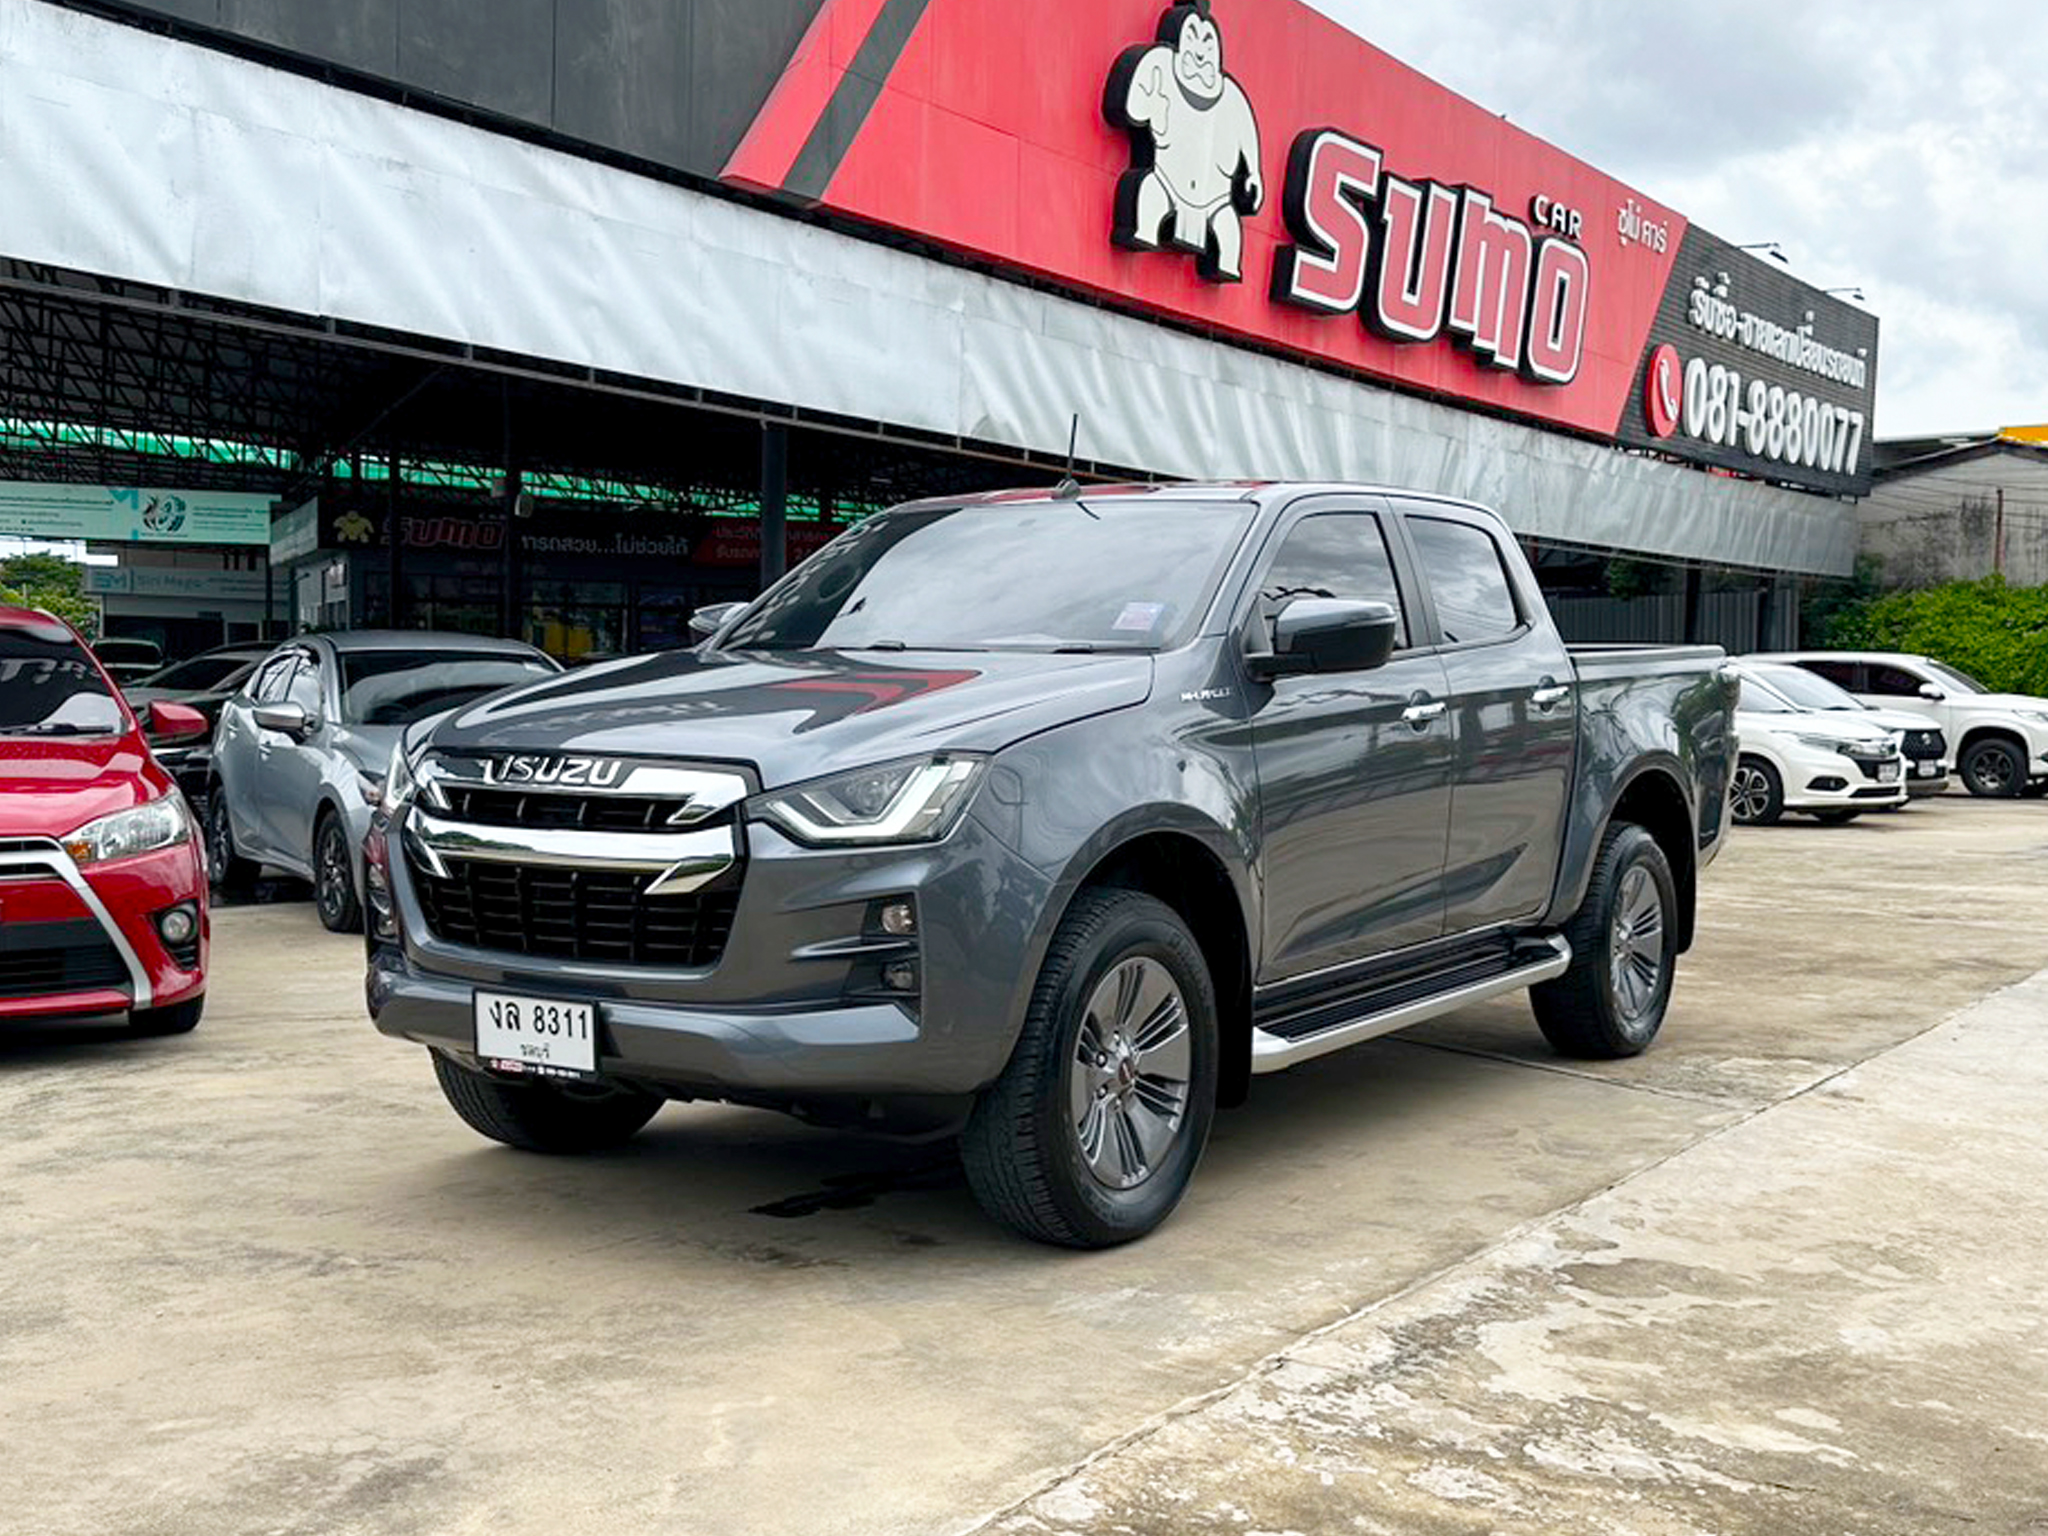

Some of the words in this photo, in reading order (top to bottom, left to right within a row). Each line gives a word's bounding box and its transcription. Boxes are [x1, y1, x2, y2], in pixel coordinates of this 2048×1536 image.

[1533, 194, 1582, 240] CAR
[1641, 219, 1668, 253] คาร์
[1684, 357, 1864, 476] 081-8880077
[498, 754, 622, 786] ISUZU
[489, 1000, 521, 1031] งล
[533, 1005, 586, 1040] 8311
